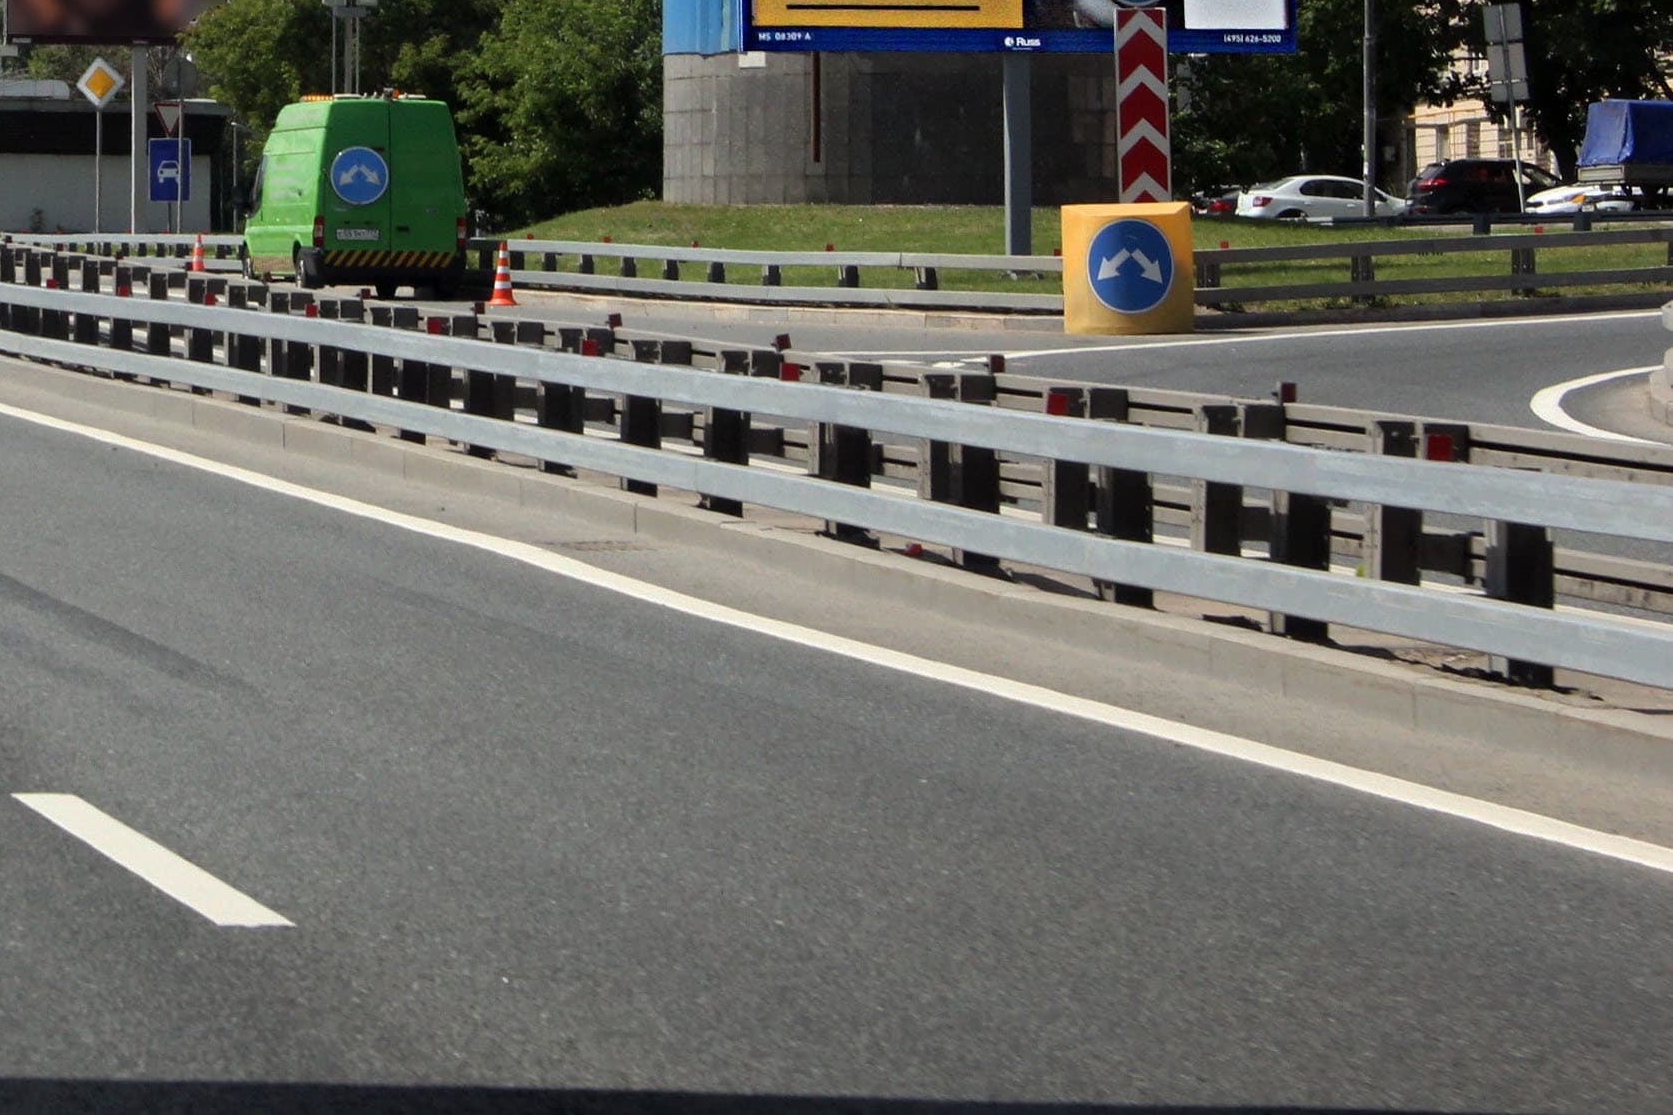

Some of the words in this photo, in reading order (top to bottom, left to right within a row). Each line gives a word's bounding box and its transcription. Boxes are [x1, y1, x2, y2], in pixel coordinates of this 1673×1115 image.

[804, 32, 811, 41] A
[1245, 34, 1282, 43] 626-5200
[1015, 36, 1041, 47] Russ
